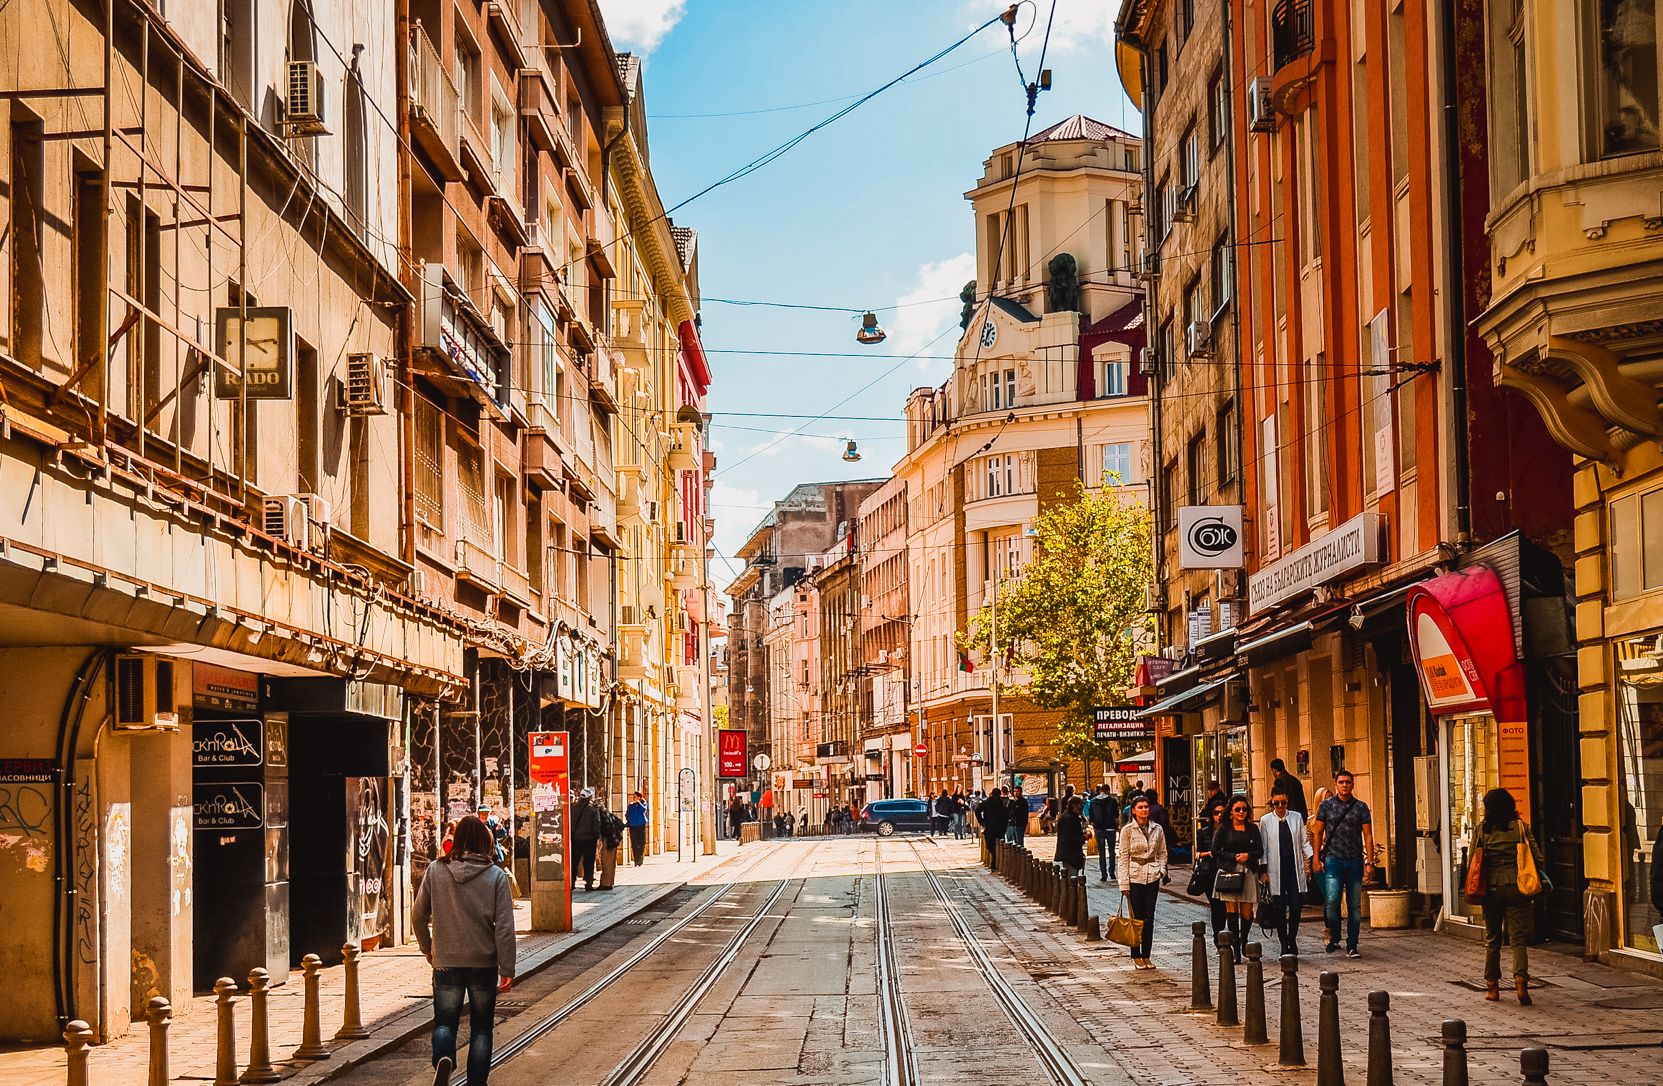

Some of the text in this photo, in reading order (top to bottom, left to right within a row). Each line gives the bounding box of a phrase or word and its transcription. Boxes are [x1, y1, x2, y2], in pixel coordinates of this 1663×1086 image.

[1265, 575, 1274, 598] НА
[1274, 553, 1312, 594] БЪЛГАРСКИТЕ
[1313, 528, 1360, 575] ЖУРНАЛИСТИ
[1097, 722, 1145, 730] ЛЕГАЛИЗАЦИЯ
[218, 754, 235, 762] Club
[1169, 775, 1192, 789] NO
[218, 817, 235, 825] Club
